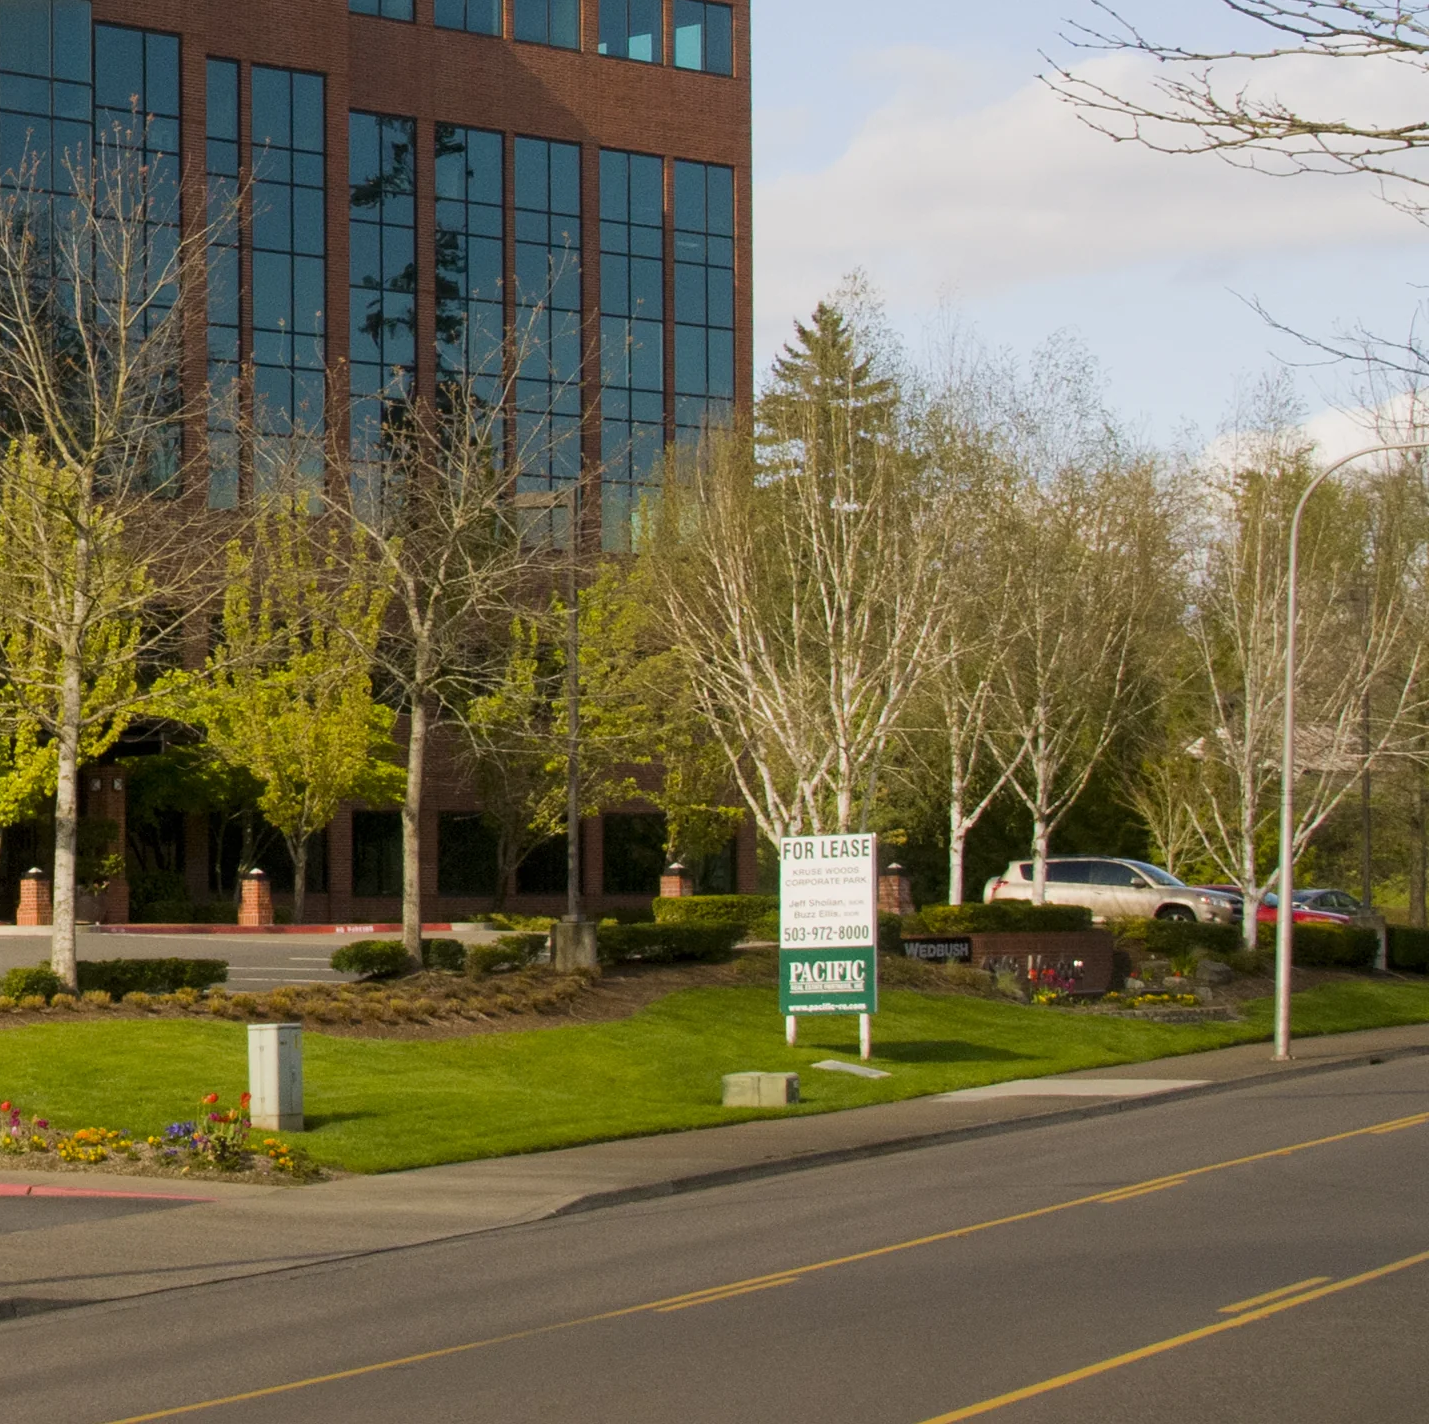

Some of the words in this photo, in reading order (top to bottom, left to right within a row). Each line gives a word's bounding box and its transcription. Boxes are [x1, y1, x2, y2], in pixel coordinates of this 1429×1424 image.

[783, 841, 814, 860] FOR
[821, 838, 870, 858] LEASE
[792, 868, 822, 876] KRUSE
[825, 866, 860, 875] WOODS
[785, 877, 841, 887] CORPORATE
[843, 876, 867, 885] PARK
[789, 899, 806, 908] Jeff
[794, 910, 817, 919] Buzz
[784, 925, 870, 942] 503-972-8000
[904, 942, 969, 957] WEDBUSH
[789, 959, 865, 982] PACIFIC
